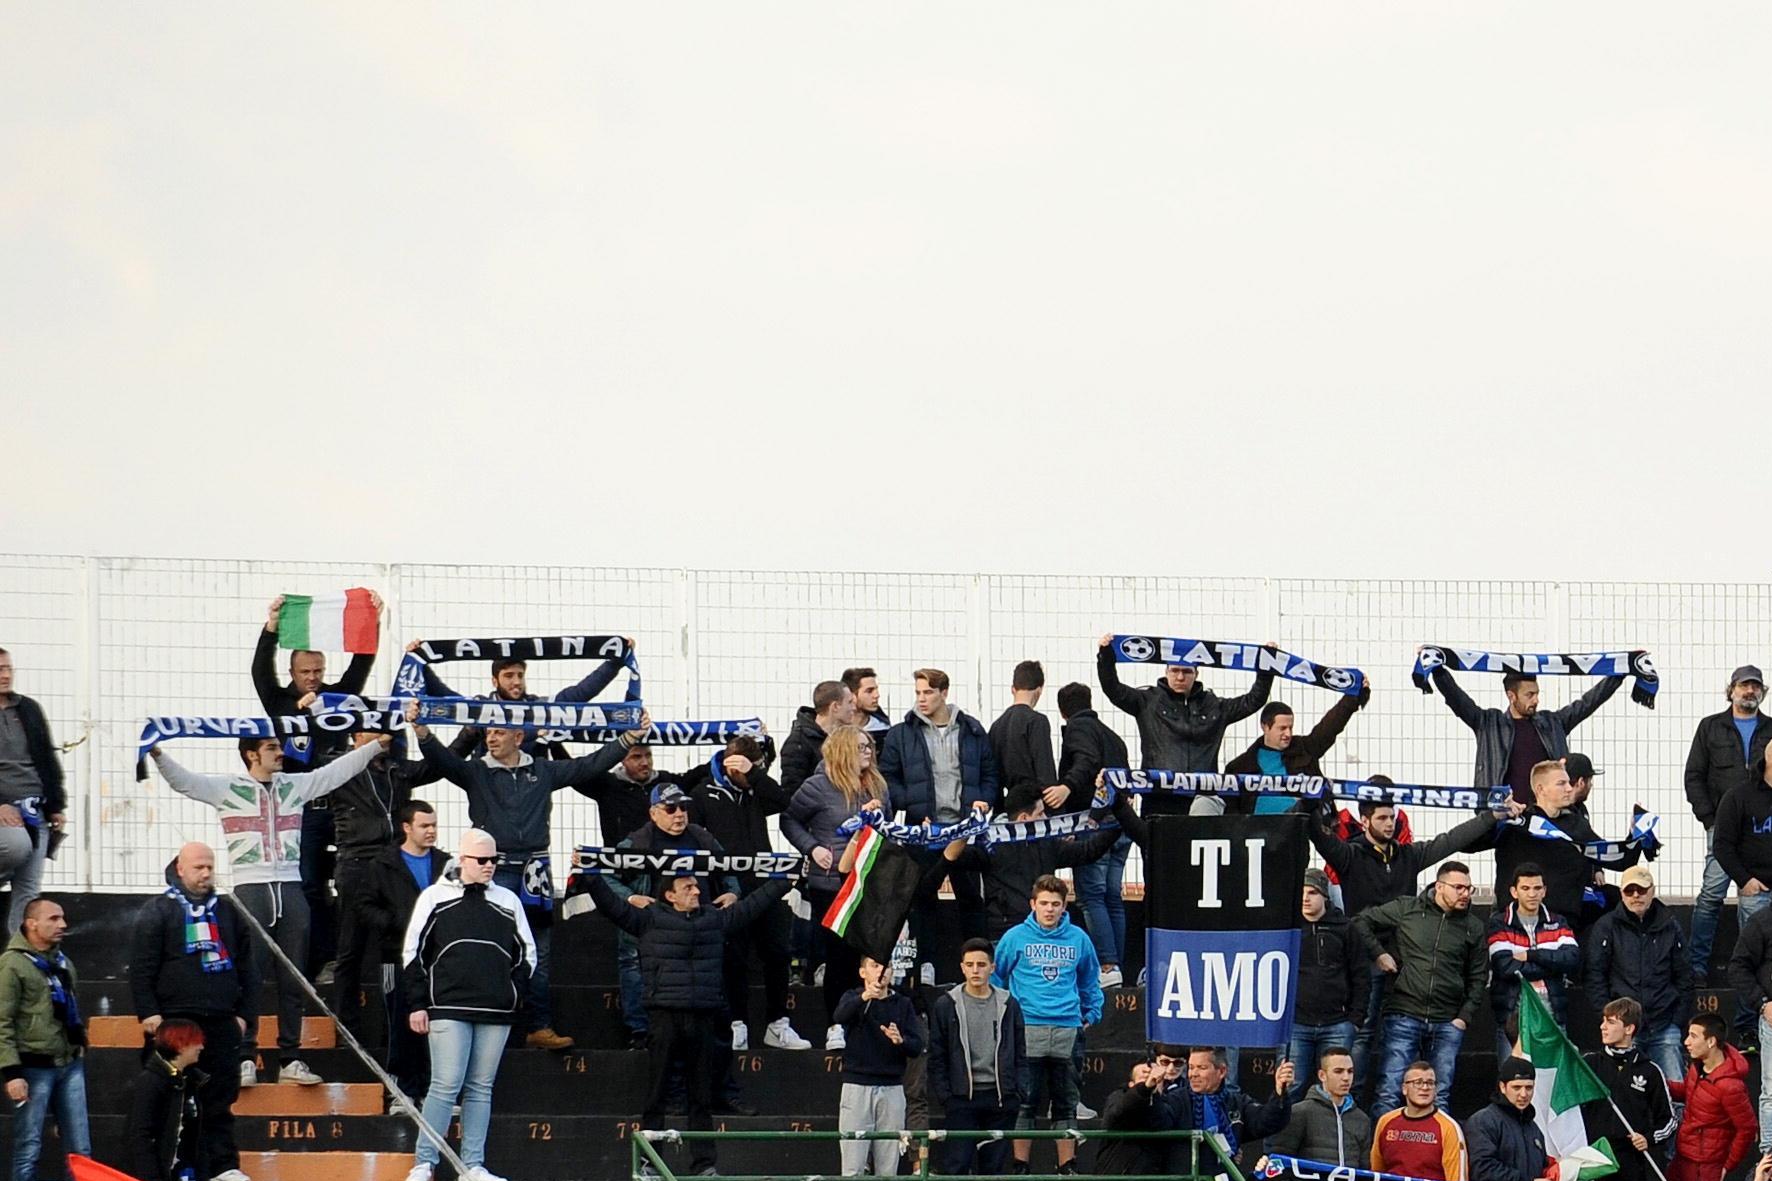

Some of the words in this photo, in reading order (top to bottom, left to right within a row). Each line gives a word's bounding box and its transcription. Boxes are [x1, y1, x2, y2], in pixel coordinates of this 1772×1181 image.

[422, 636, 624, 660] LATINA
[1159, 640, 1316, 683] LATINA
[281, 711, 406, 733] NORD
[456, 705, 609, 726] LATINA
[1109, 770, 1154, 790] U.S.
[1160, 771, 1239, 793] LATINA
[1244, 773, 1325, 796] CALCIO
[1332, 782, 1478, 808] LATINA
[988, 812, 1096, 843] ATINA
[576, 852, 702, 872] CURVA
[708, 854, 797, 873] NORD
[1190, 838, 1266, 909] TI
[1025, 944, 1077, 960] OXFORD
[1157, 949, 1290, 1020] AMO
[565, 1056, 587, 1072] 74
[738, 1057, 762, 1072] 76
[269, 1121, 316, 1138] FILA
[529, 1122, 552, 1140] 72
